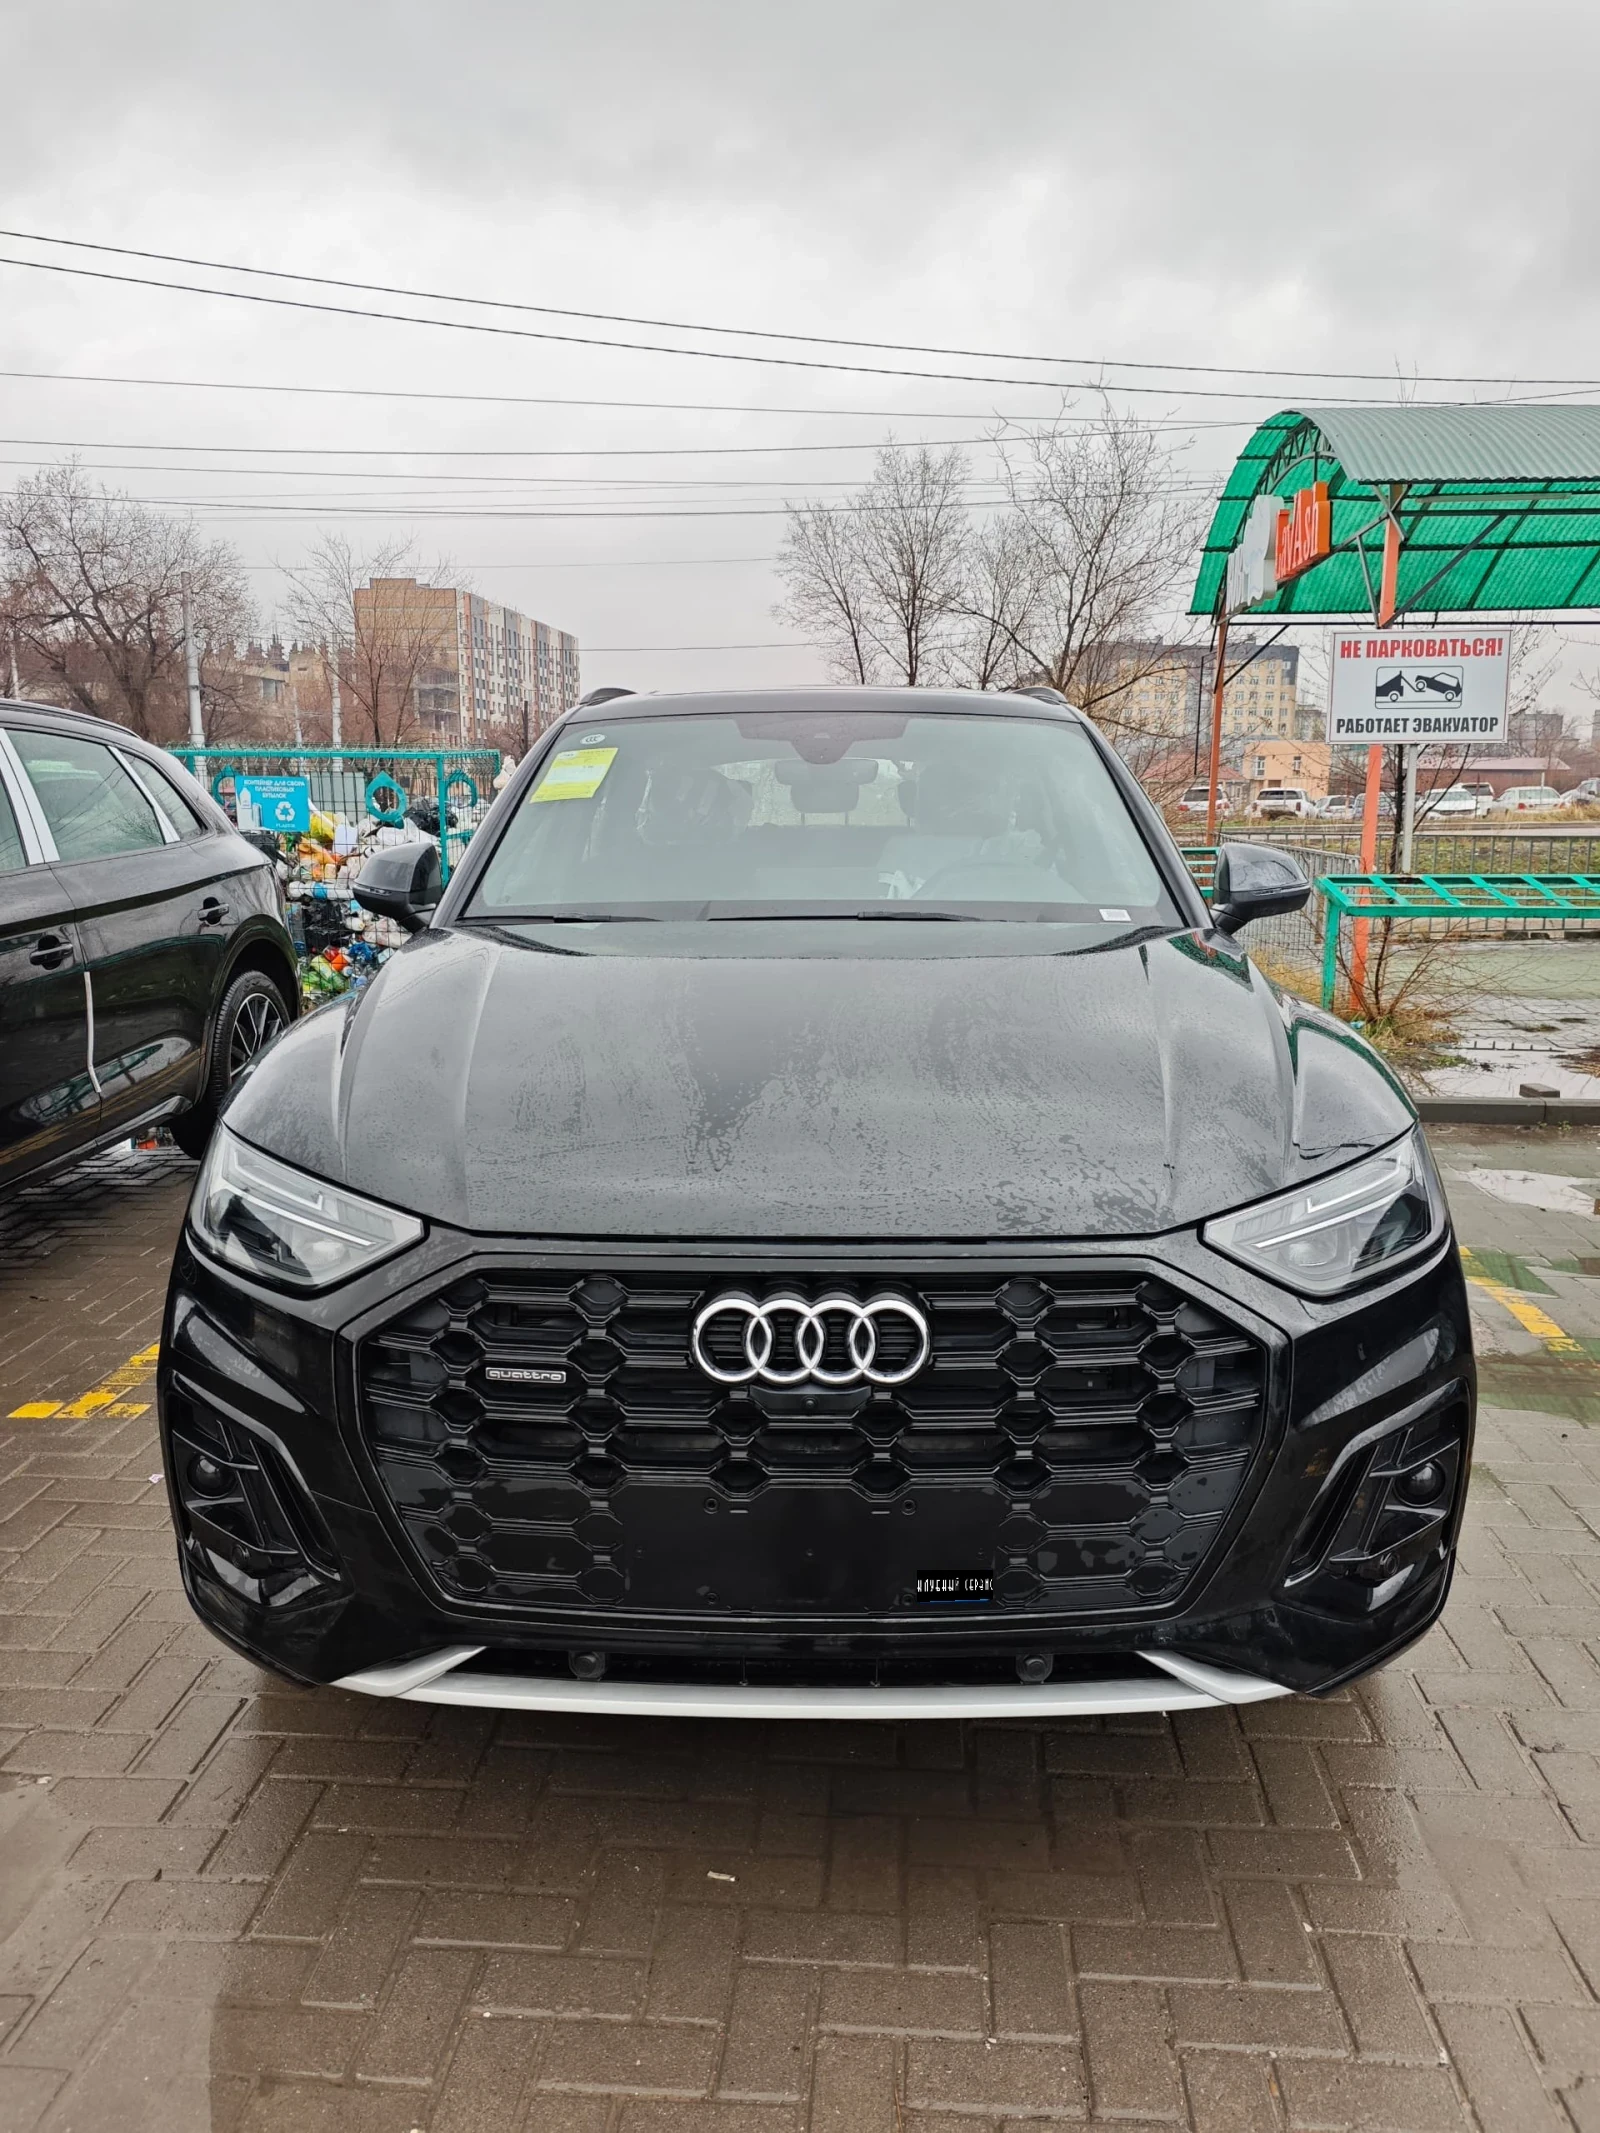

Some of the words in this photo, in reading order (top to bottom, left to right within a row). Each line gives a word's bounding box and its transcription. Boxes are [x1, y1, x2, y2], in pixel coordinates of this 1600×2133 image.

[1340, 640, 1361, 658] НЕ
[1366, 638, 1503, 658] ПАРКОВАТЬСЯ!
[1336, 718, 1409, 733] РАБОТАЕТ
[1413, 717, 1499, 733] ЭВАКУАТОР
[488, 1369, 562, 1380] quattro
